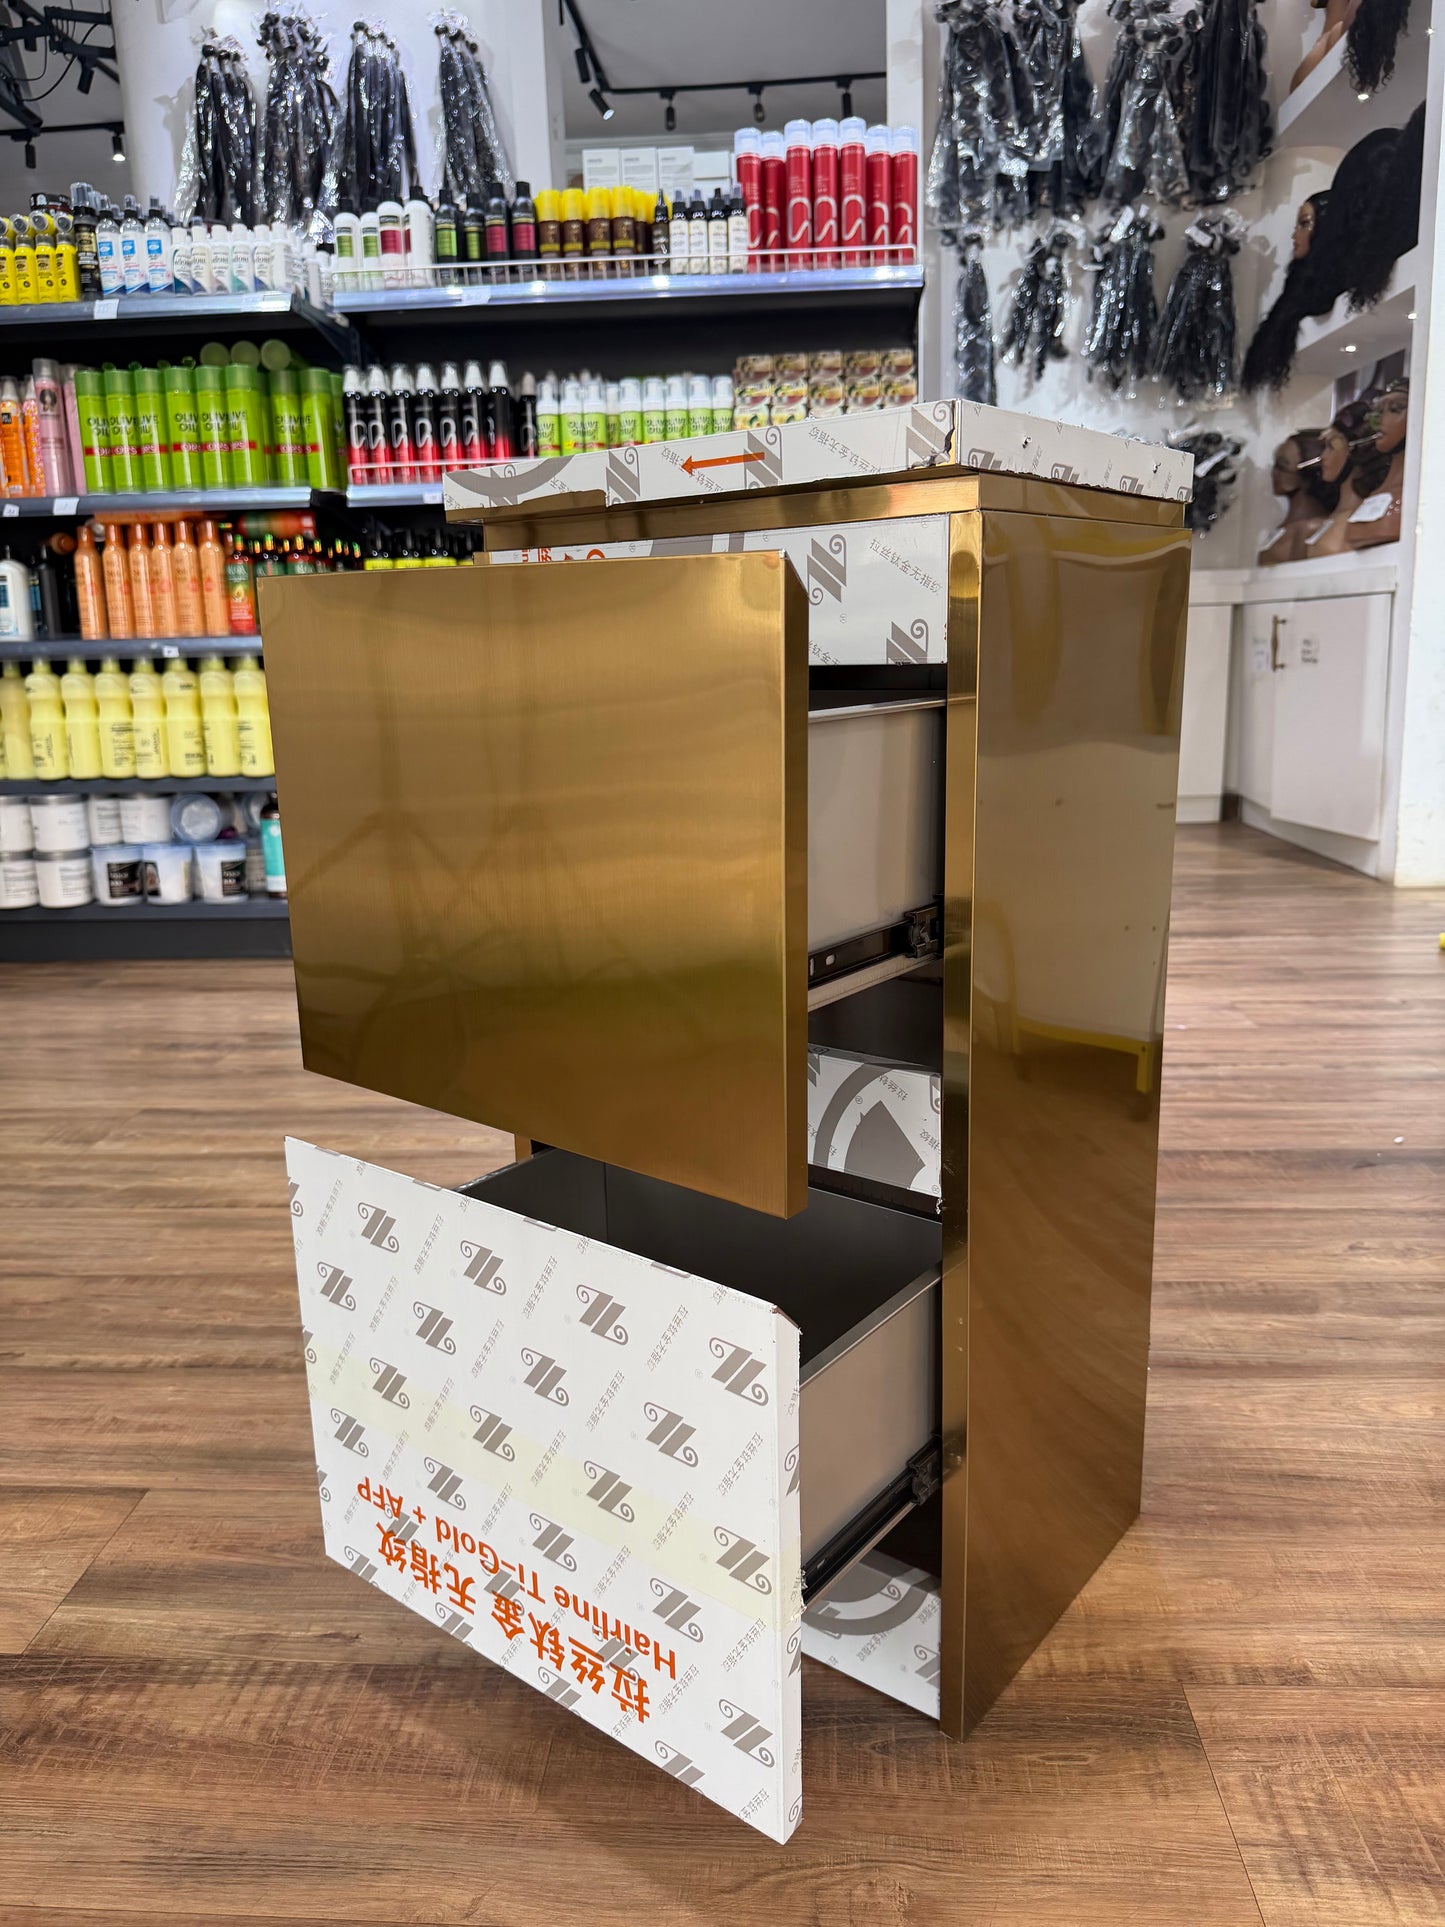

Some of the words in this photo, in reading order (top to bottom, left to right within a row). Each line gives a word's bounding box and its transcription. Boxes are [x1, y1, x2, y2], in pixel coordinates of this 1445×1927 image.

[869, 538, 942, 595] 拉丝钛金无指纹
[646, 1304, 689, 1372] 拉丝钛金无指纹
[717, 1432, 764, 1497] 拉丝钛金无指纹
[357, 1476, 404, 1519] AFP
[412, 1505, 427, 1525] +
[652, 1491, 695, 1551] 拉丝钛金无指纹
[435, 1515, 546, 1605] Ti-Gold
[553, 1584, 677, 1681] Hairline
[721, 1617, 767, 1672] 拉丝钛金无指纹
